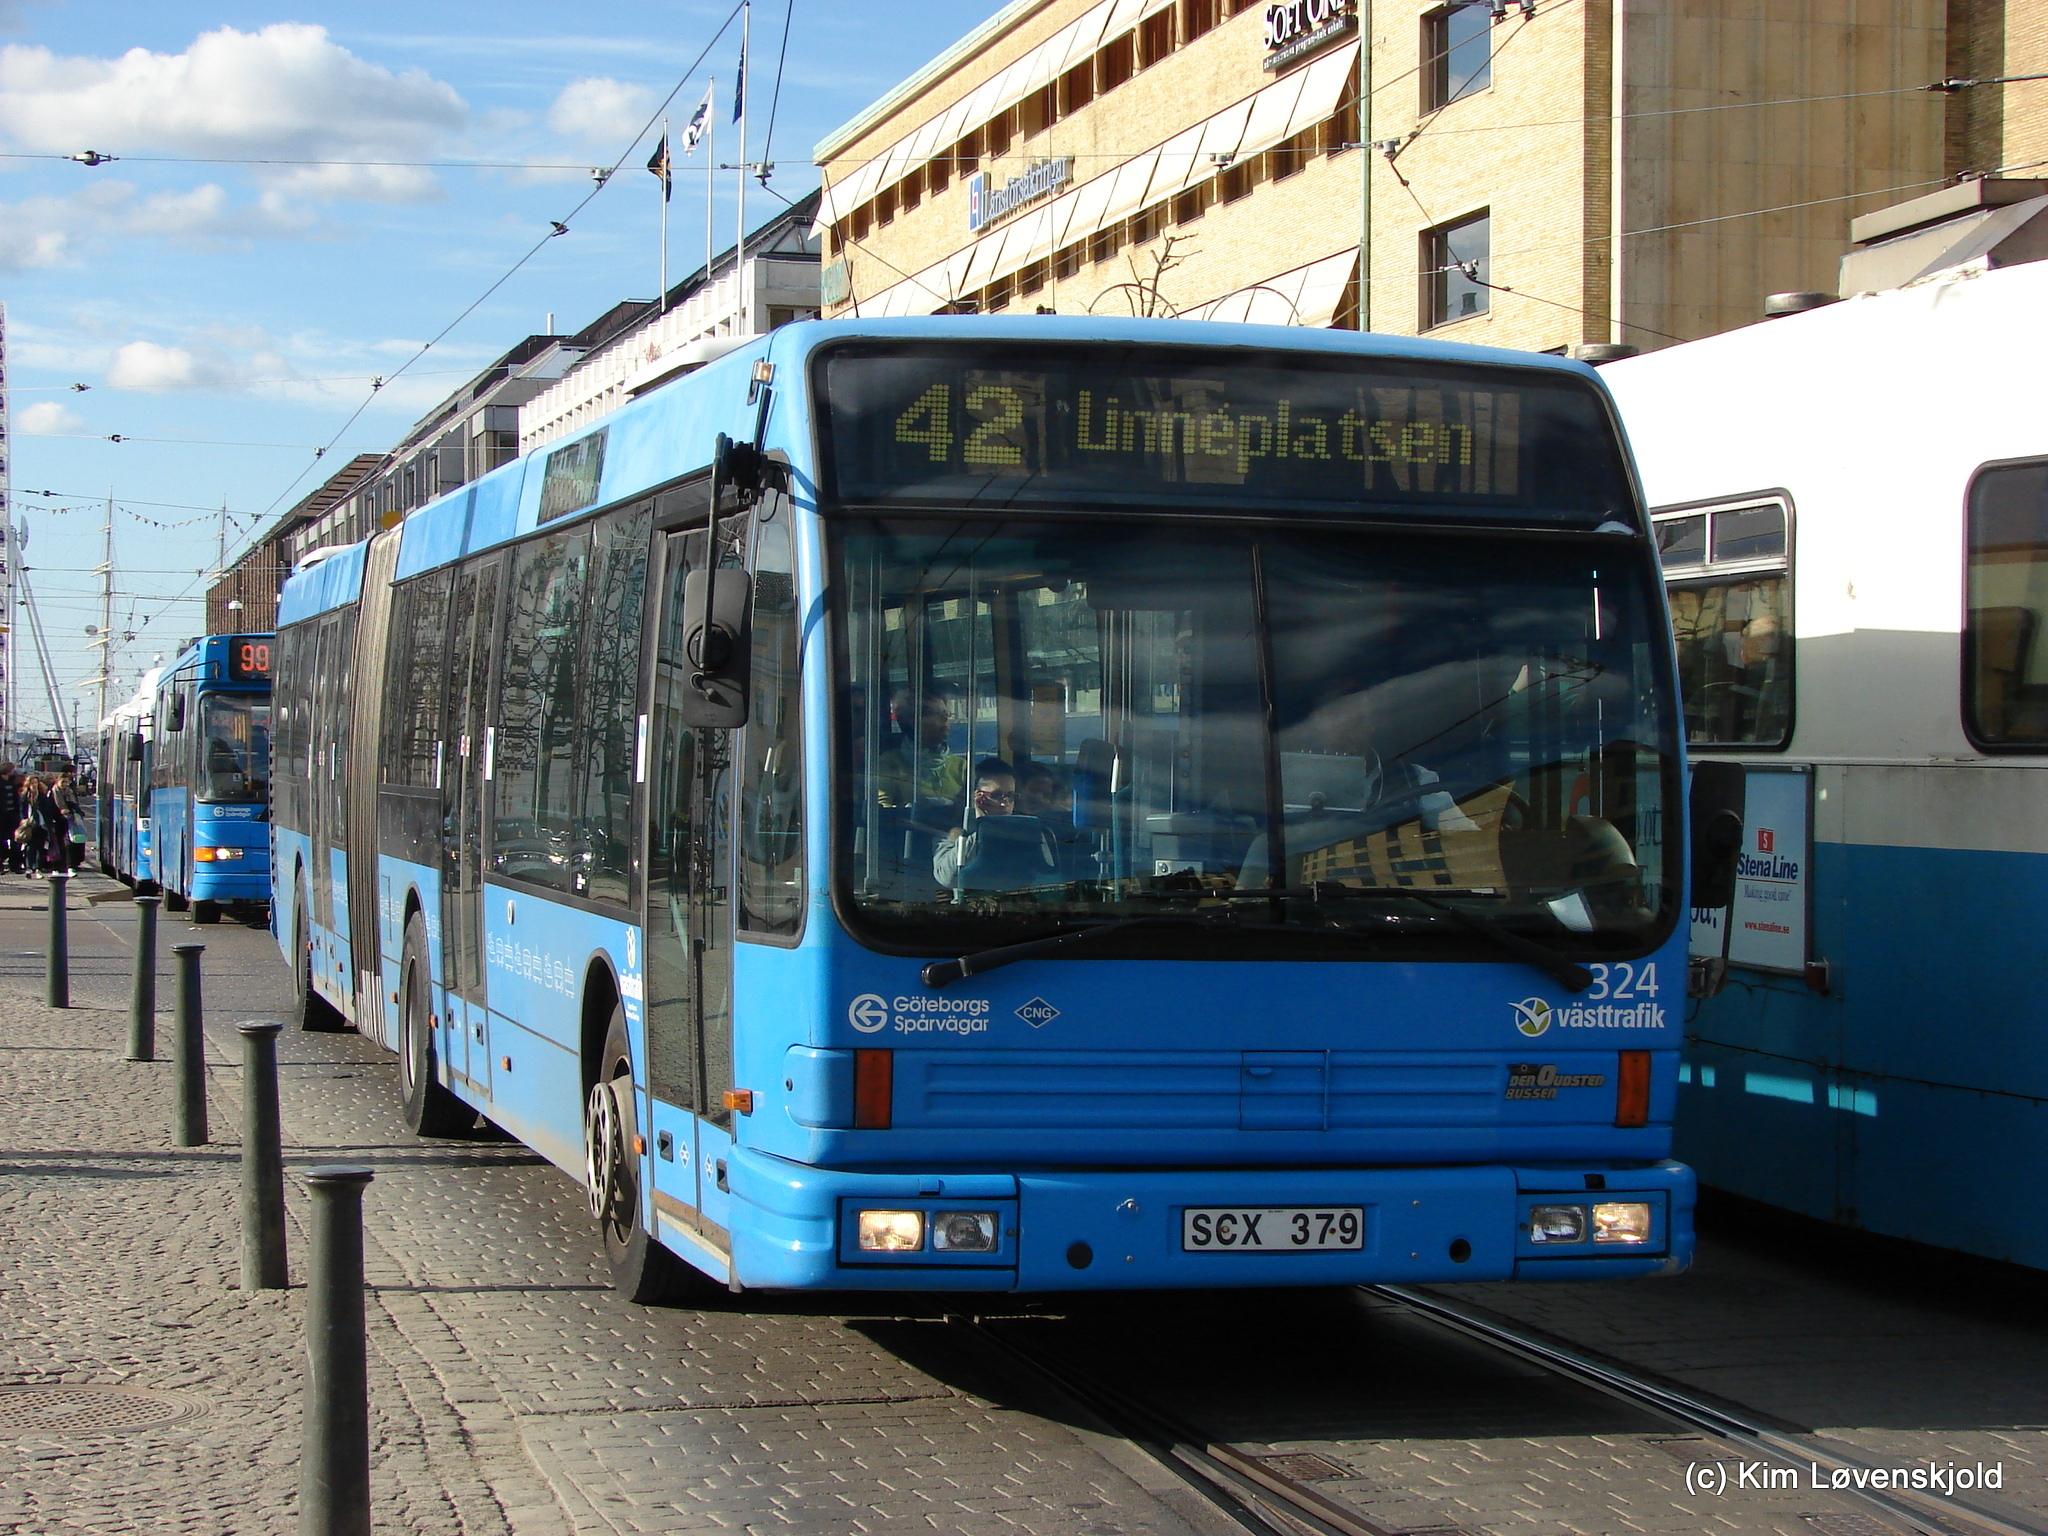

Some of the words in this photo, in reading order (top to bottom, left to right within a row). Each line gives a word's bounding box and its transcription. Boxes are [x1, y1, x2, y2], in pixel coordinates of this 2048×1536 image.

[895, 384, 1022, 464] 42
[1077, 390, 1471, 474] Linnéplatsen
[1737, 853, 1771, 878] Stena
[1772, 855, 1798, 880] Line
[1588, 962, 1659, 1000] 324
[893, 996, 990, 1016] Göteborgs
[1023, 1007, 1051, 1019] CNG
[1557, 1002, 1666, 1028] västtrafik
[894, 1014, 989, 1035] Spårvägar
[1505, 1088, 1558, 1099] BUSSEN
[1191, 1213, 1262, 1246] SCX
[1291, 1212, 1358, 1245] 379
